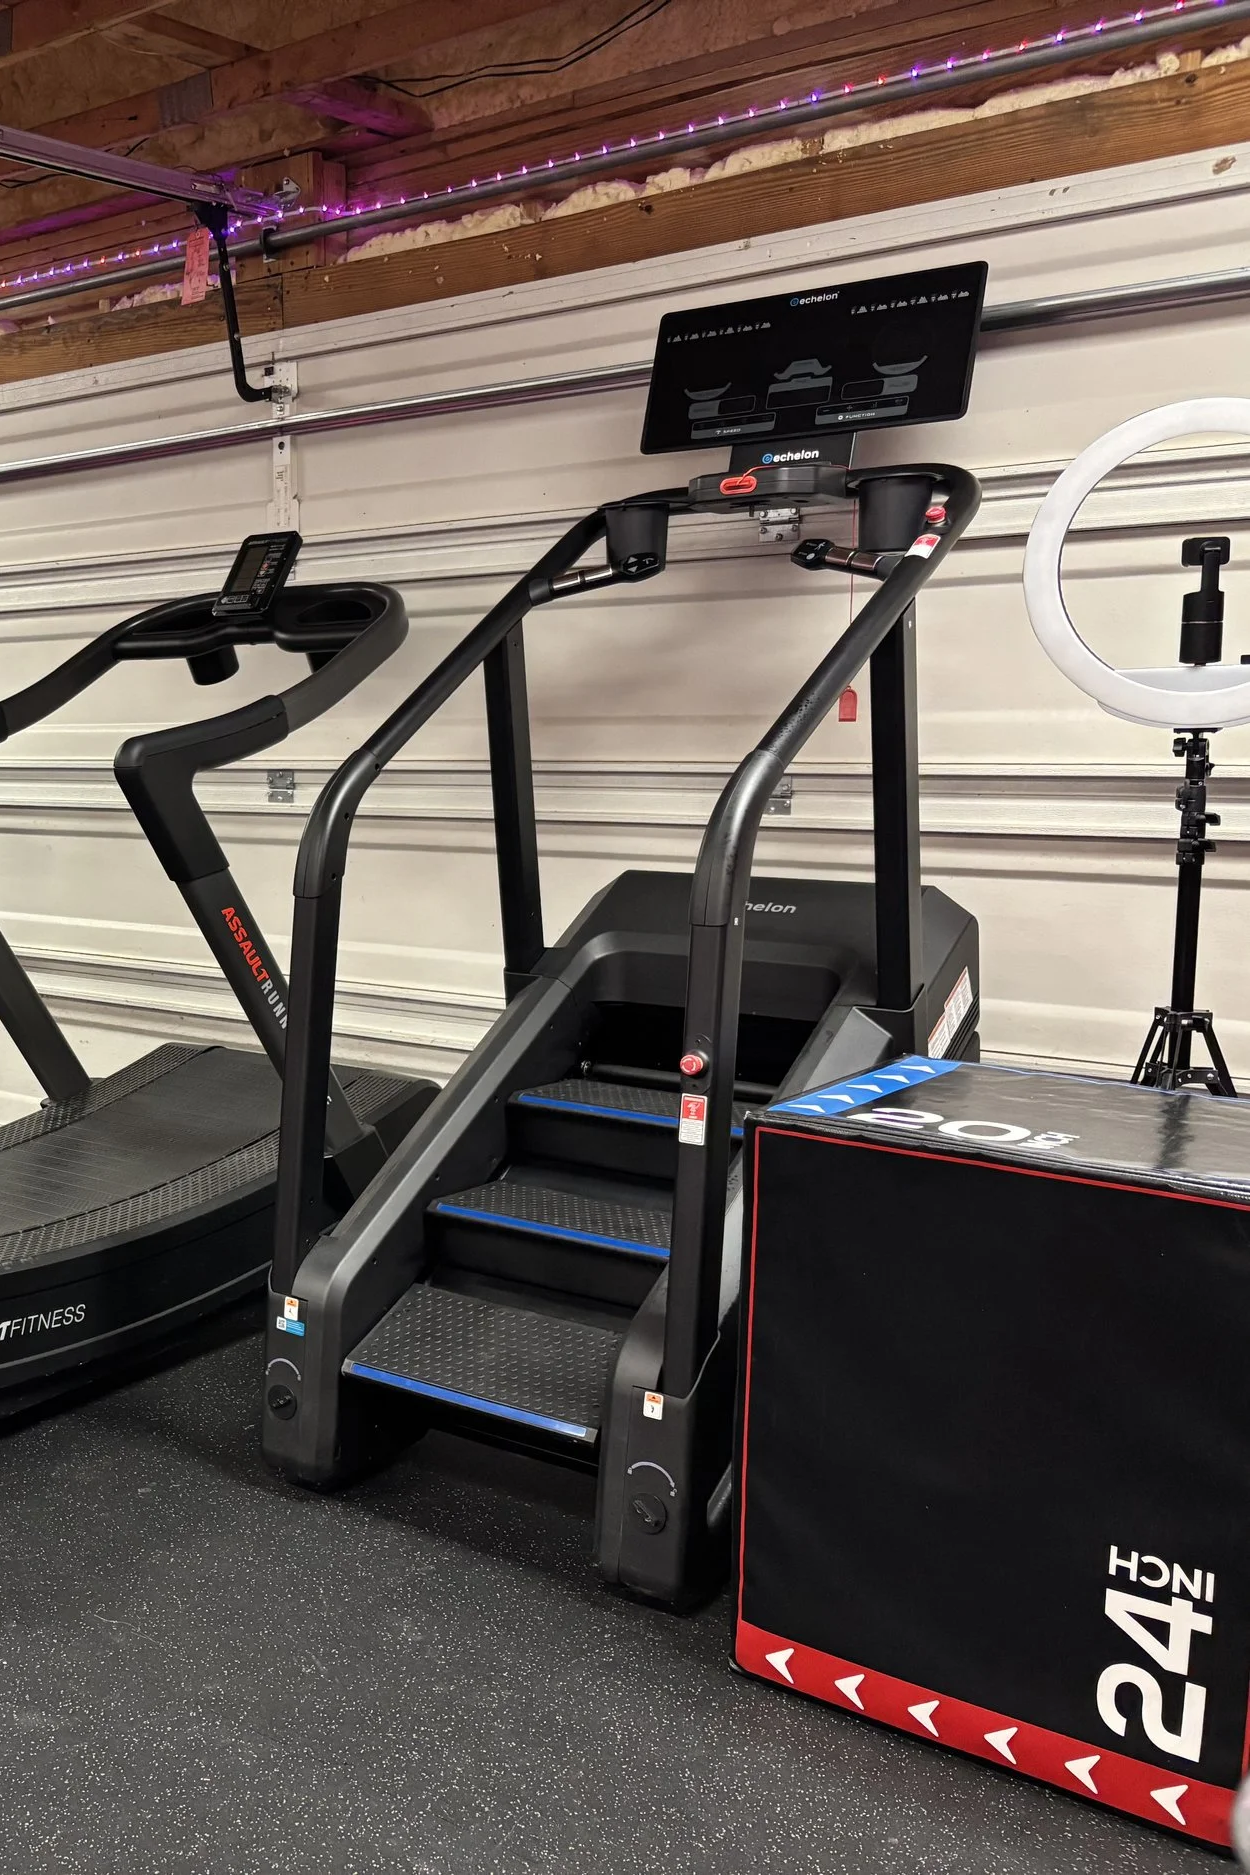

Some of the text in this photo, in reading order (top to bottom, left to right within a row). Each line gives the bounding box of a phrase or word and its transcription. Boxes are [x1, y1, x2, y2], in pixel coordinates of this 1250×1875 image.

[800, 291, 839, 305] echelon
[773, 449, 819, 463] echelon
[745, 901, 797, 914] helon
[1108, 1544, 1215, 1603] INCH
[1096, 1587, 1213, 1764] 24
